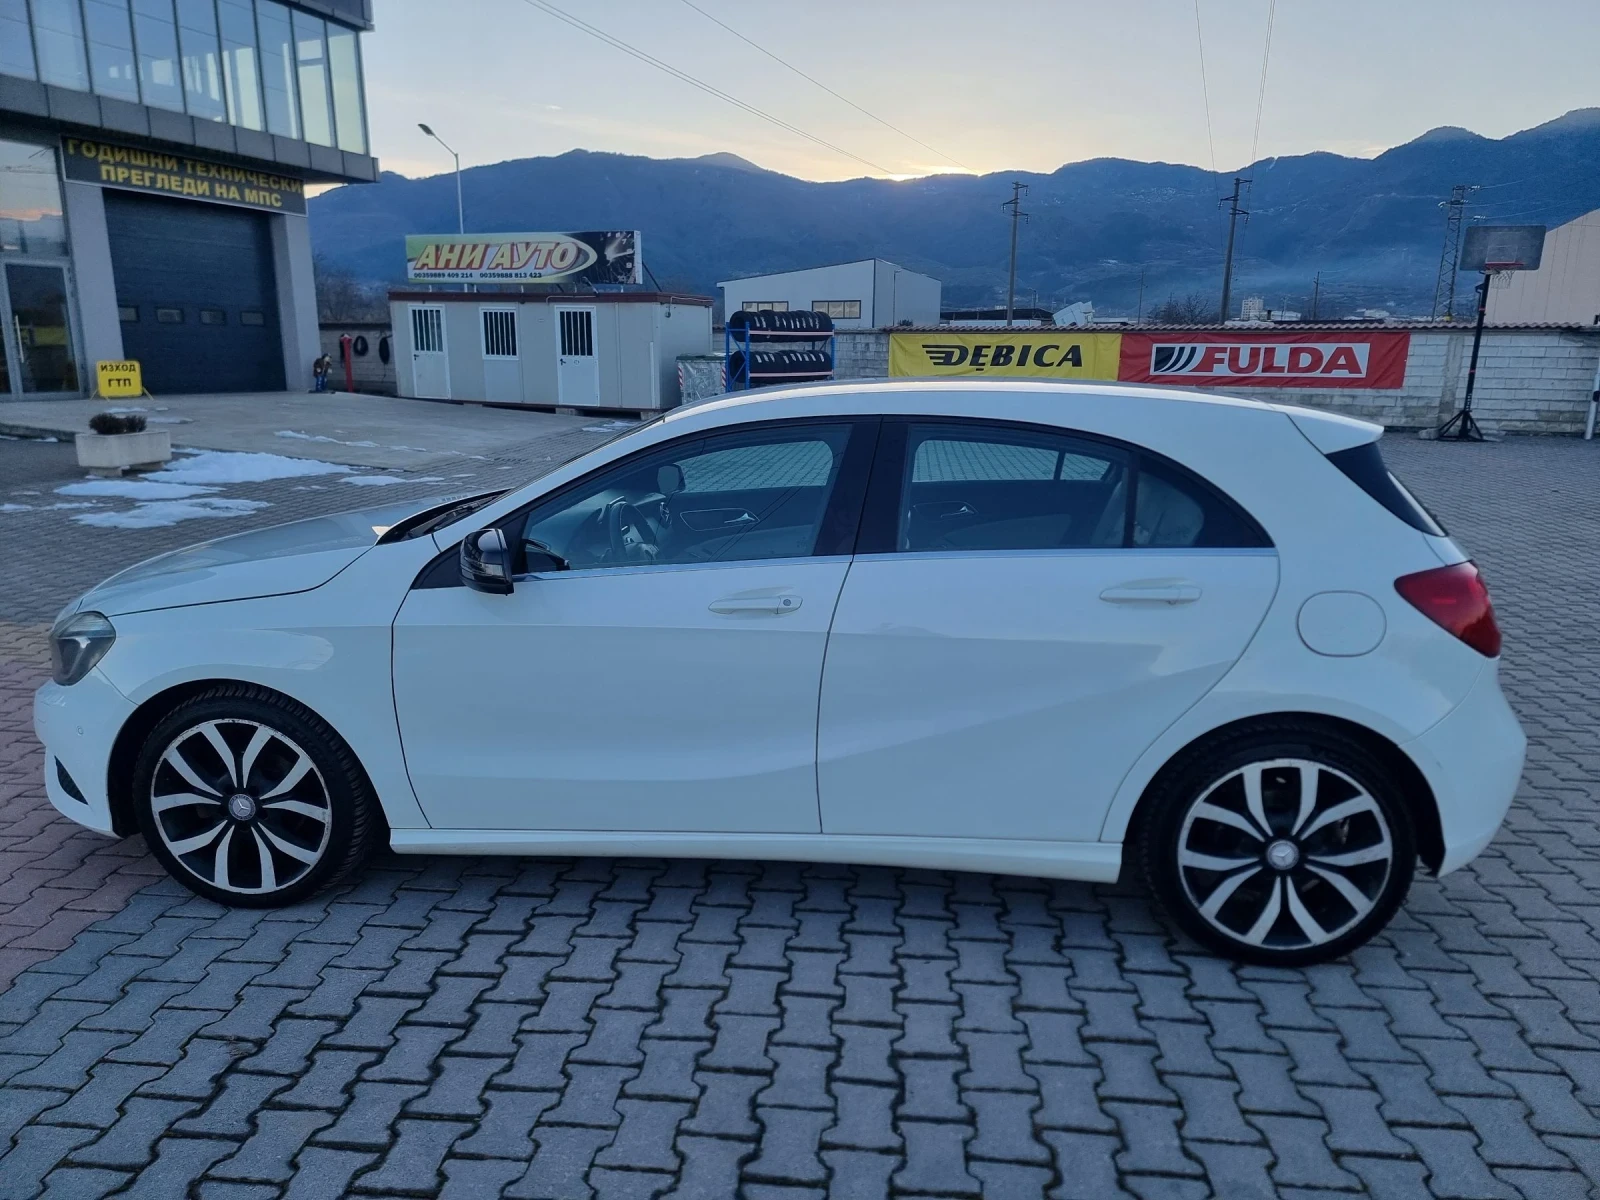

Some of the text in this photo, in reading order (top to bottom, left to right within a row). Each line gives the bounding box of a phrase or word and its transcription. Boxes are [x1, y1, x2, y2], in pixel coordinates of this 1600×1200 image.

[67, 139, 304, 194] ГОДИШНИ ТЕХНИЧЕСКИ
[100, 163, 282, 208] ПРЕГЛЕДИ НА МПС
[413, 242, 578, 270] АНИ АУТО
[100, 364, 137, 373] ИЗХОД
[1188, 346, 1363, 374] FULDA
[108, 378, 131, 388] ГТП
